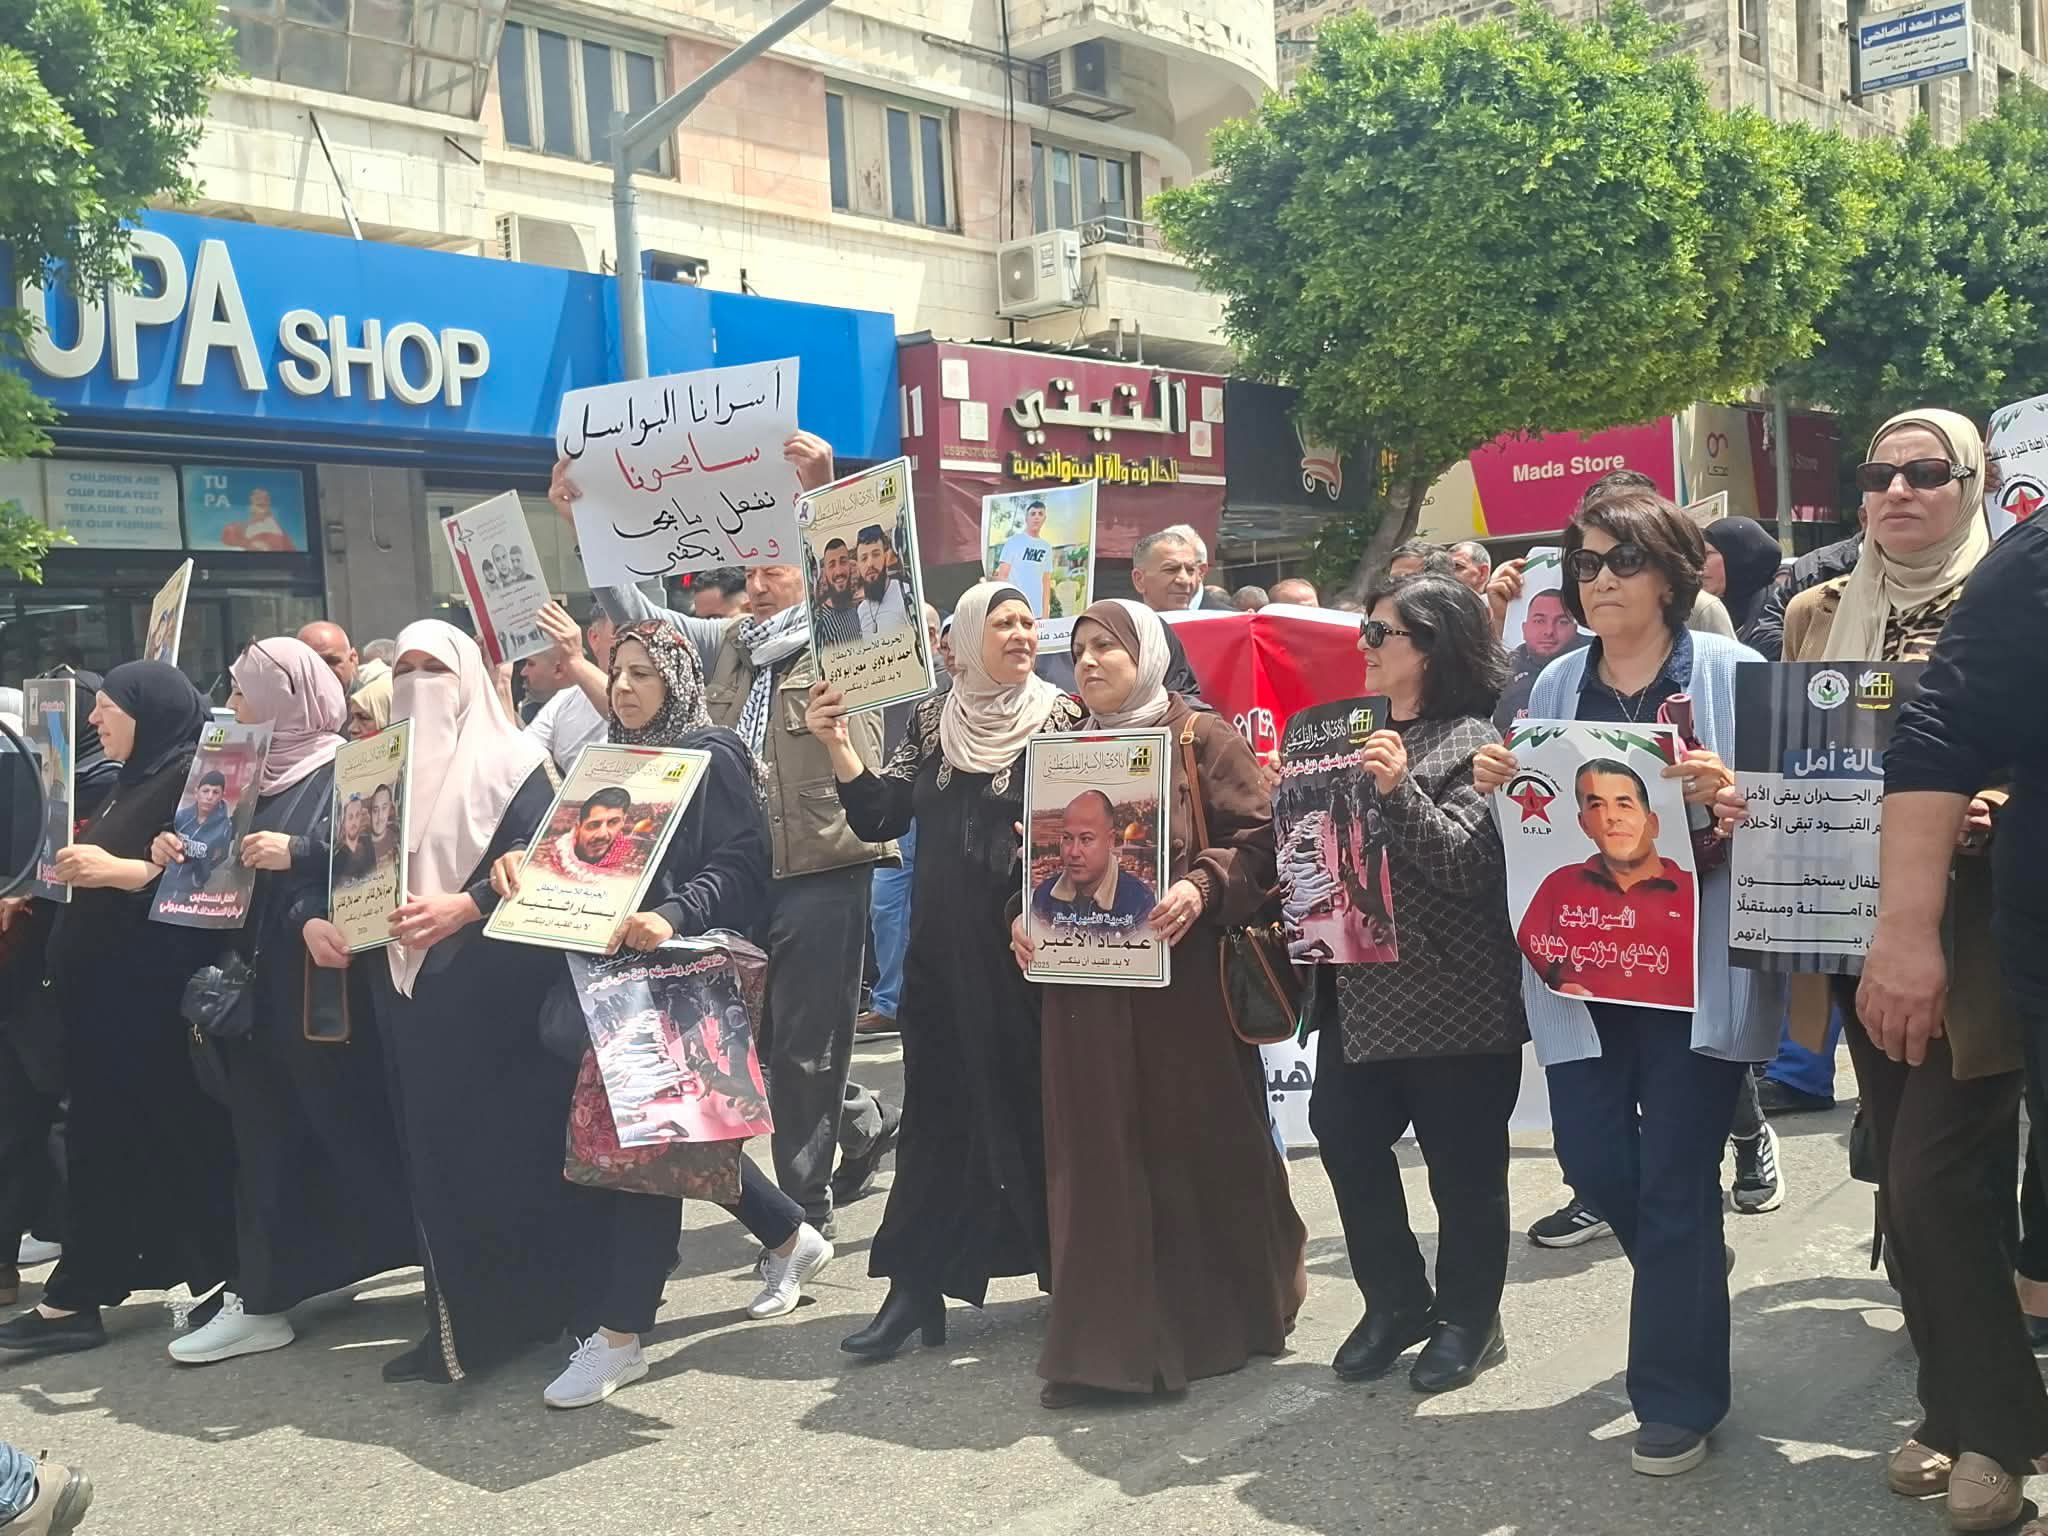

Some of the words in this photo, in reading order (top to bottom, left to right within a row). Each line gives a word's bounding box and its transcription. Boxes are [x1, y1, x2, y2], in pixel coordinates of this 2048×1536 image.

[17, 228, 268, 391] UPA
[278, 309, 490, 407] SHOP
[564, 388, 677, 459] البواسل
[615, 432, 760, 492] سامحونا
[1513, 462, 1565, 483] Mada
[1570, 454, 1625, 475] Store
[202, 475, 228, 489] TU
[204, 493, 230, 508] PA
[1794, 740, 1836, 776] أمل
[1843, 747, 1885, 776] الة
[1744, 784, 1770, 802] الأمل
[1773, 788, 1800, 805] يبقى
[1804, 788, 1871, 805] الجدران
[1740, 813, 1782, 829] الأحلام
[1785, 817, 1813, 834] تبقى
[1816, 817, 1870, 833] القيود
[1737, 874, 1846, 890] يستحقون
[1848, 874, 1880, 890] طفال
[1560, 904, 1598, 928] الرفيق
[1796, 901, 1863, 916] آمنة
[1598, 906, 1635, 930] الأسير
[1097, 933, 1151, 950] عماد
[1571, 940, 1617, 972] عزمي
[1621, 943, 1669, 977] وجدي
